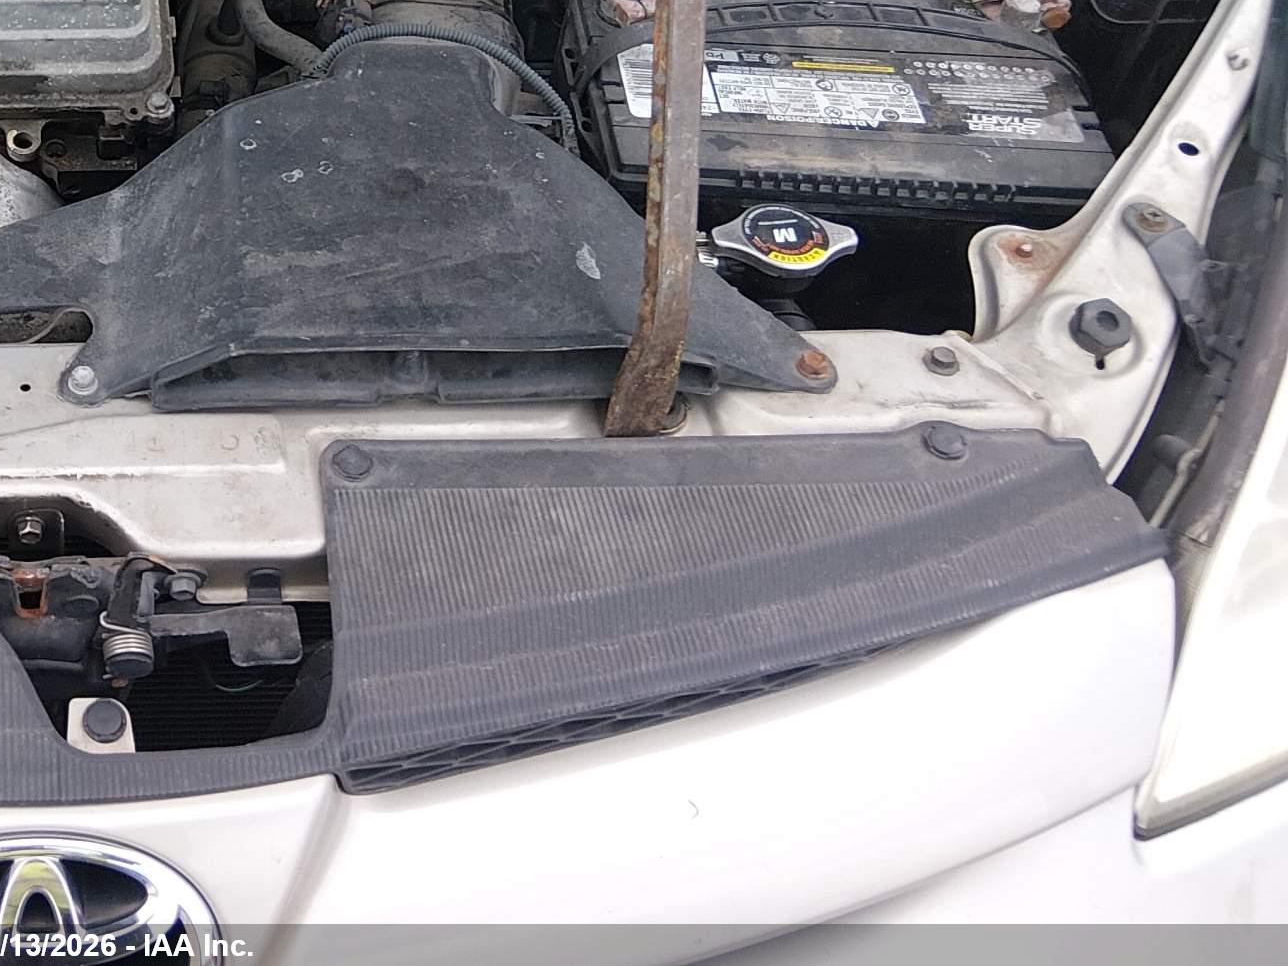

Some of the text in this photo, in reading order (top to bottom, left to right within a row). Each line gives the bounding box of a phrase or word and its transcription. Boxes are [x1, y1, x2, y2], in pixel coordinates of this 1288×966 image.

[766, 115, 868, 126] DANGER/POISON
[972, 115, 1043, 126] START
[968, 124, 1038, 135] SUPER
